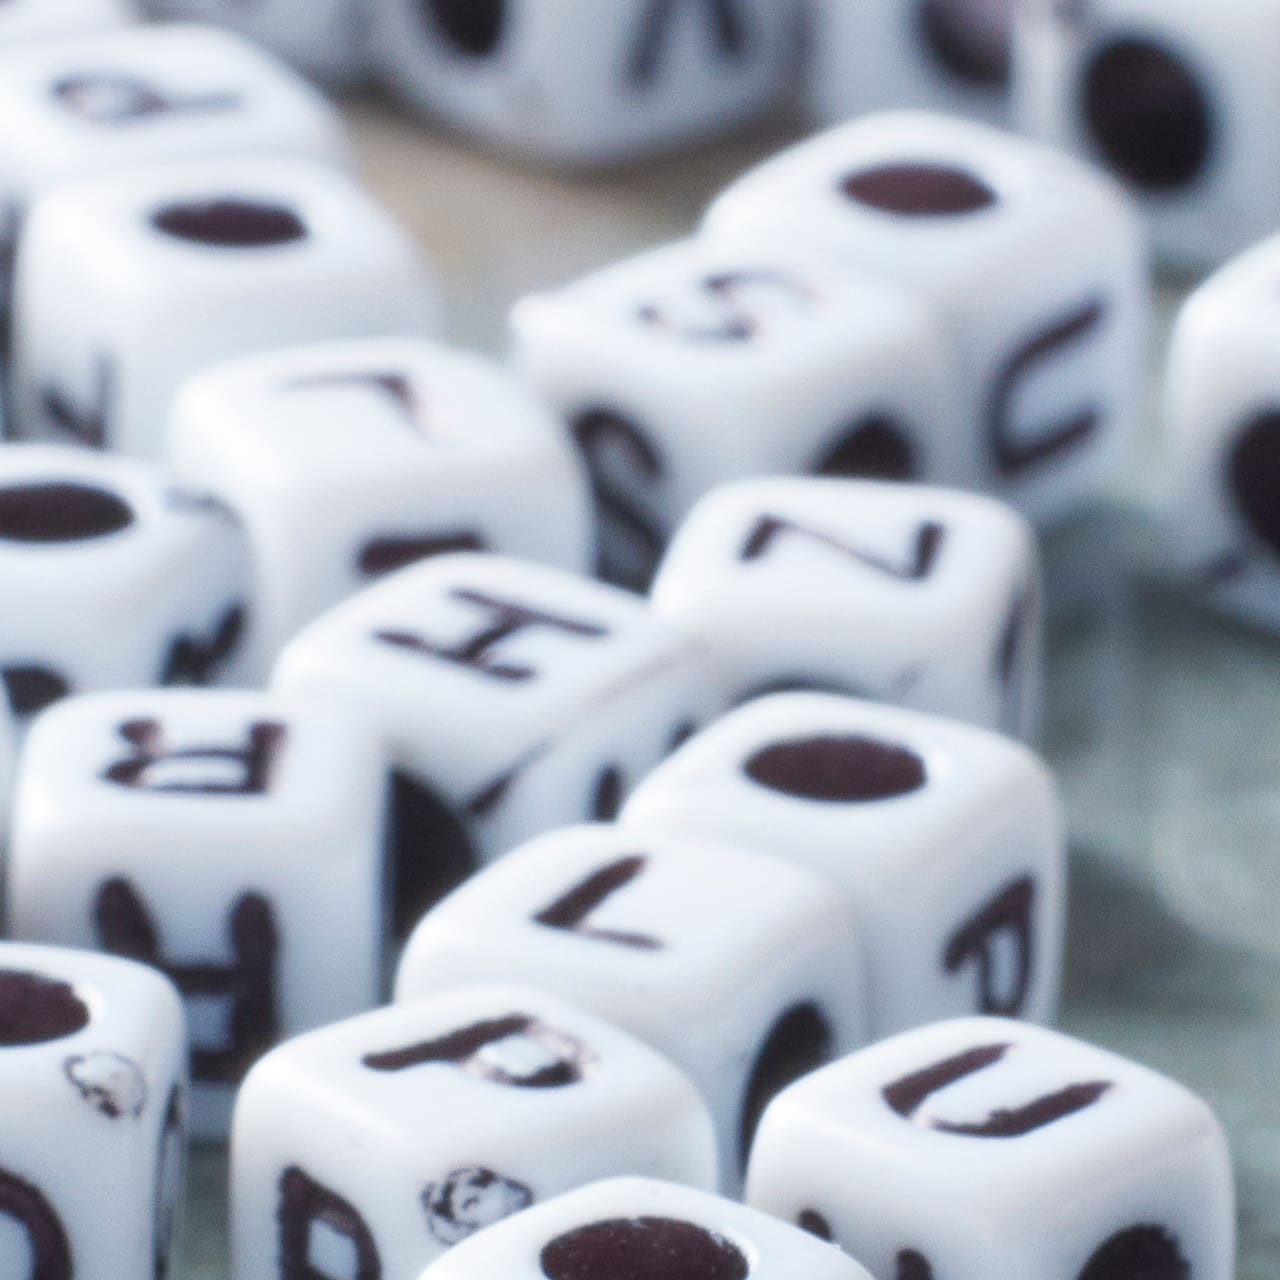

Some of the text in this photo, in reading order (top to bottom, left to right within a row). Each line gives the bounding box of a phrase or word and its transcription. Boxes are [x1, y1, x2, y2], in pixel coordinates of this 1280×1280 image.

[635, 272, 821, 342] S
[372, 587, 610, 681] H
[361, 1012, 600, 1088] P
[882, 1042, 1118, 1138] U
